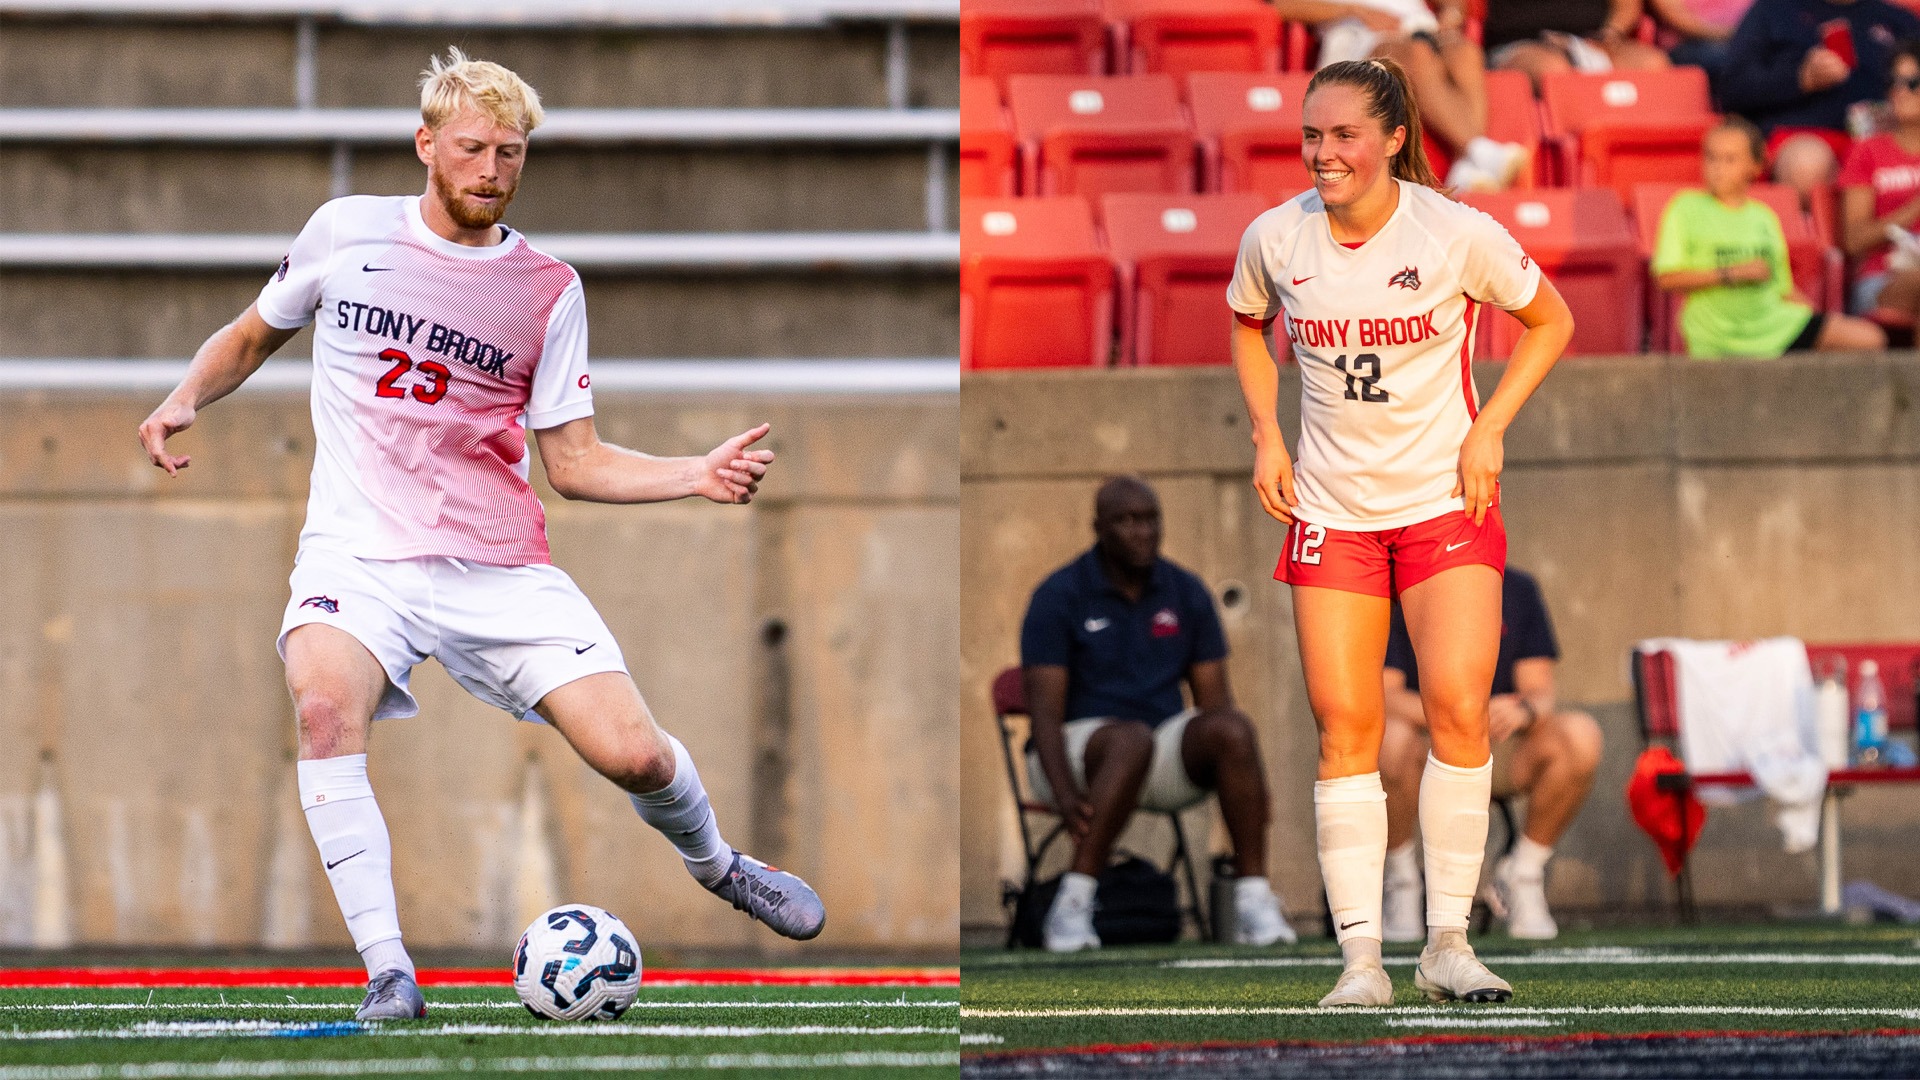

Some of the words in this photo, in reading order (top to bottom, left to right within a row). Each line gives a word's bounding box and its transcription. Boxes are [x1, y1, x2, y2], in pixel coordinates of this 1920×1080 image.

[338, 300, 426, 345] STONY
[426, 323, 514, 380] BROOK
[1288, 315, 1350, 348] STONY
[1359, 309, 1440, 347] BROOK
[375, 347, 452, 405] 23
[1334, 353, 1389, 403] 12
[1291, 521, 1327, 566] 12
[315, 794, 325, 802] 23
